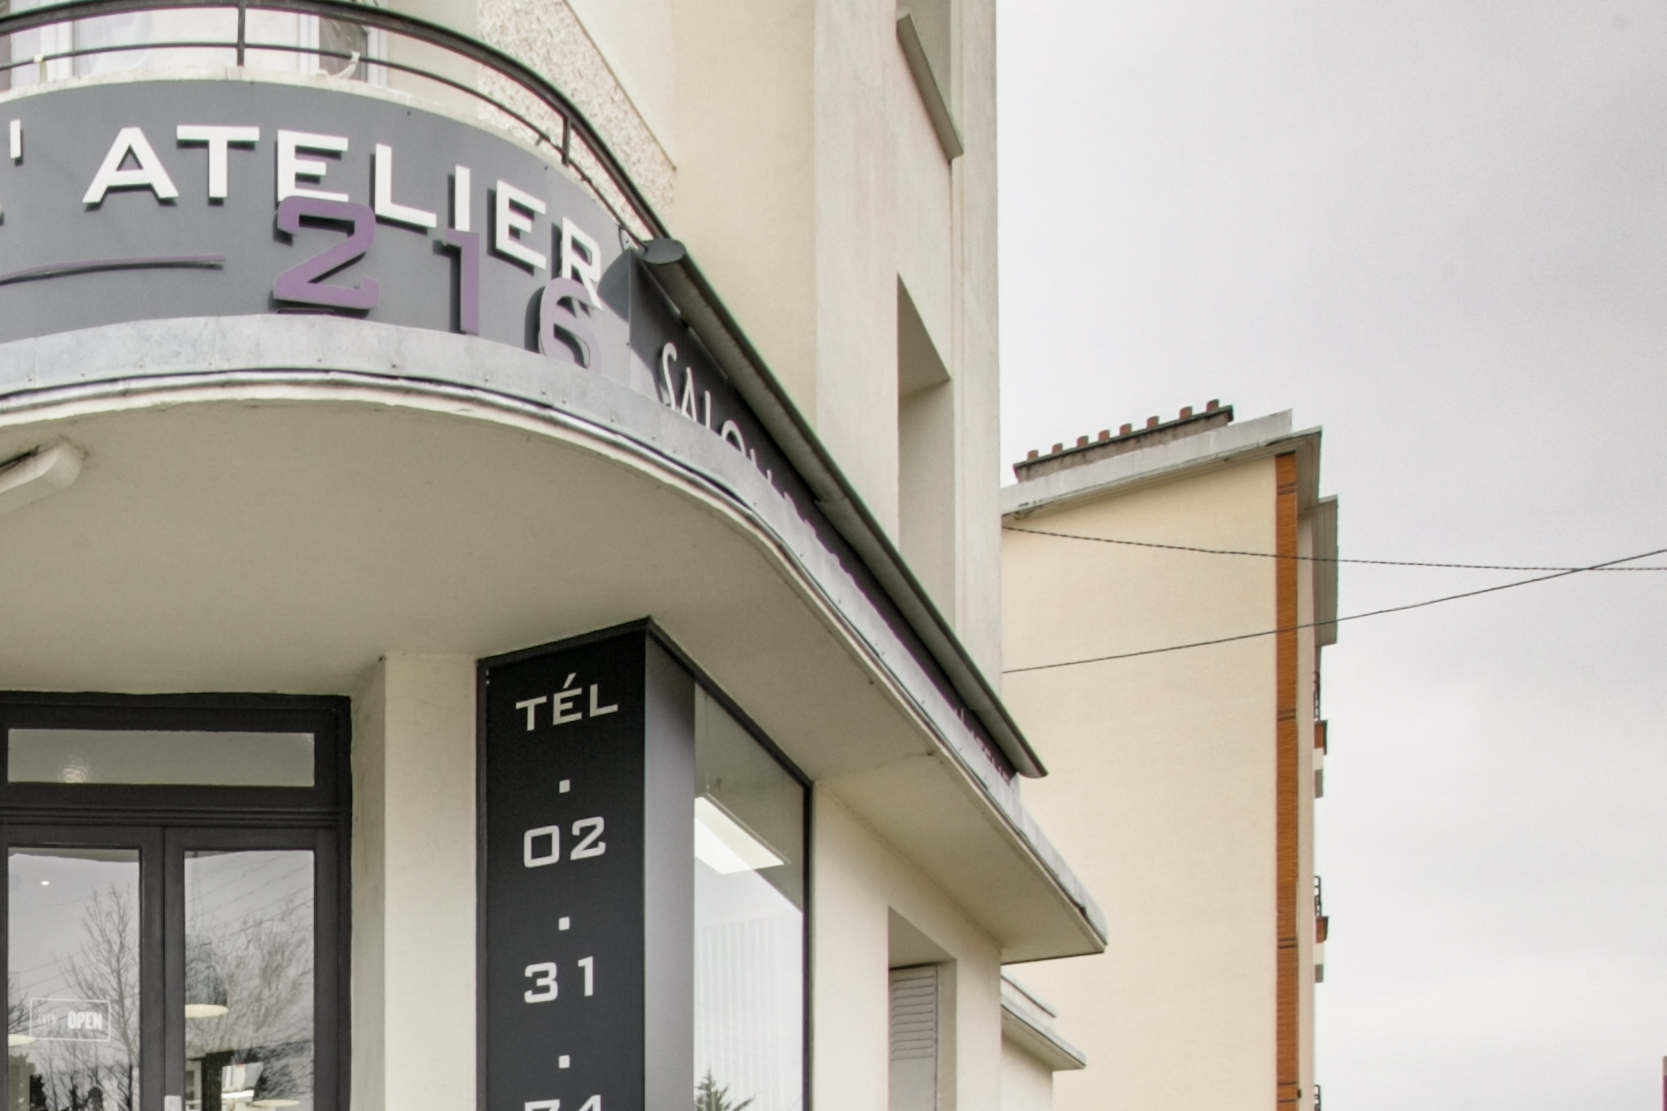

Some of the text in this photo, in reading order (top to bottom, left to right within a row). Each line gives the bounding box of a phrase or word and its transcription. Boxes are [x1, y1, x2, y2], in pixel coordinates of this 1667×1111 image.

[82, 124, 604, 312] ATELIER
[272, 194, 602, 372] 216
[515, 672, 618, 731] TÉL
[523, 816, 607, 868] 02
[524, 956, 594, 1004] 31
[67, 1011, 103, 1030] OPEN
